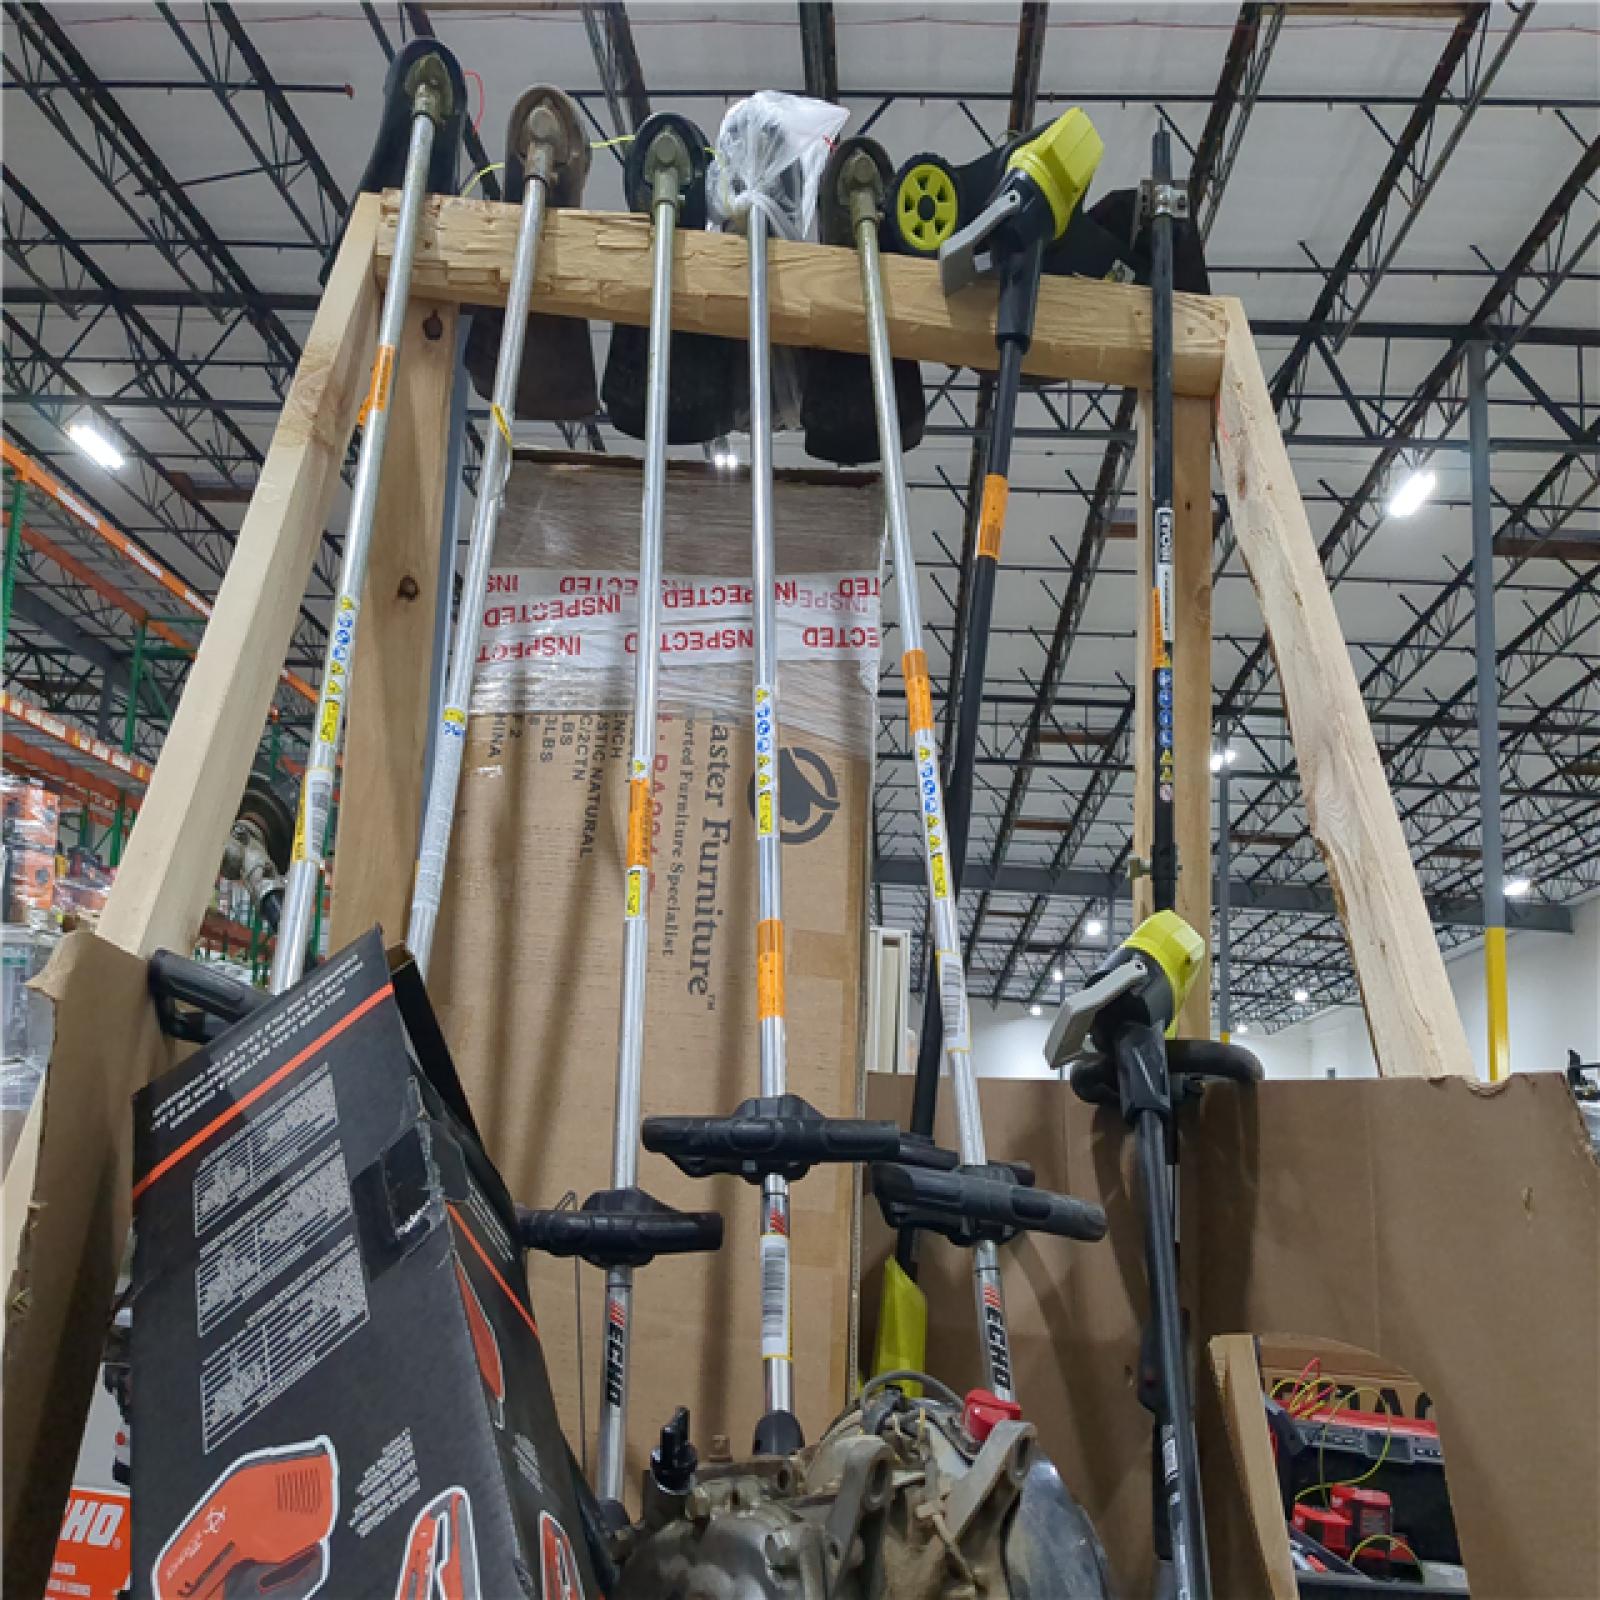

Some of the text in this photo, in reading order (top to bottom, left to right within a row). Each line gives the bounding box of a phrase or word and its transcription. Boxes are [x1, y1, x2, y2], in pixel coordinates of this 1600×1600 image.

[483, 594, 621, 628] INSPECTED
[580, 767, 603, 858] NATURAL
[672, 769, 693, 858] Furniture
[663, 862, 685, 958] Specialist
[607, 1322, 624, 1408] ECHO
[985, 1306, 1010, 1391] ECHO
[60, 1498, 124, 1549] HO
